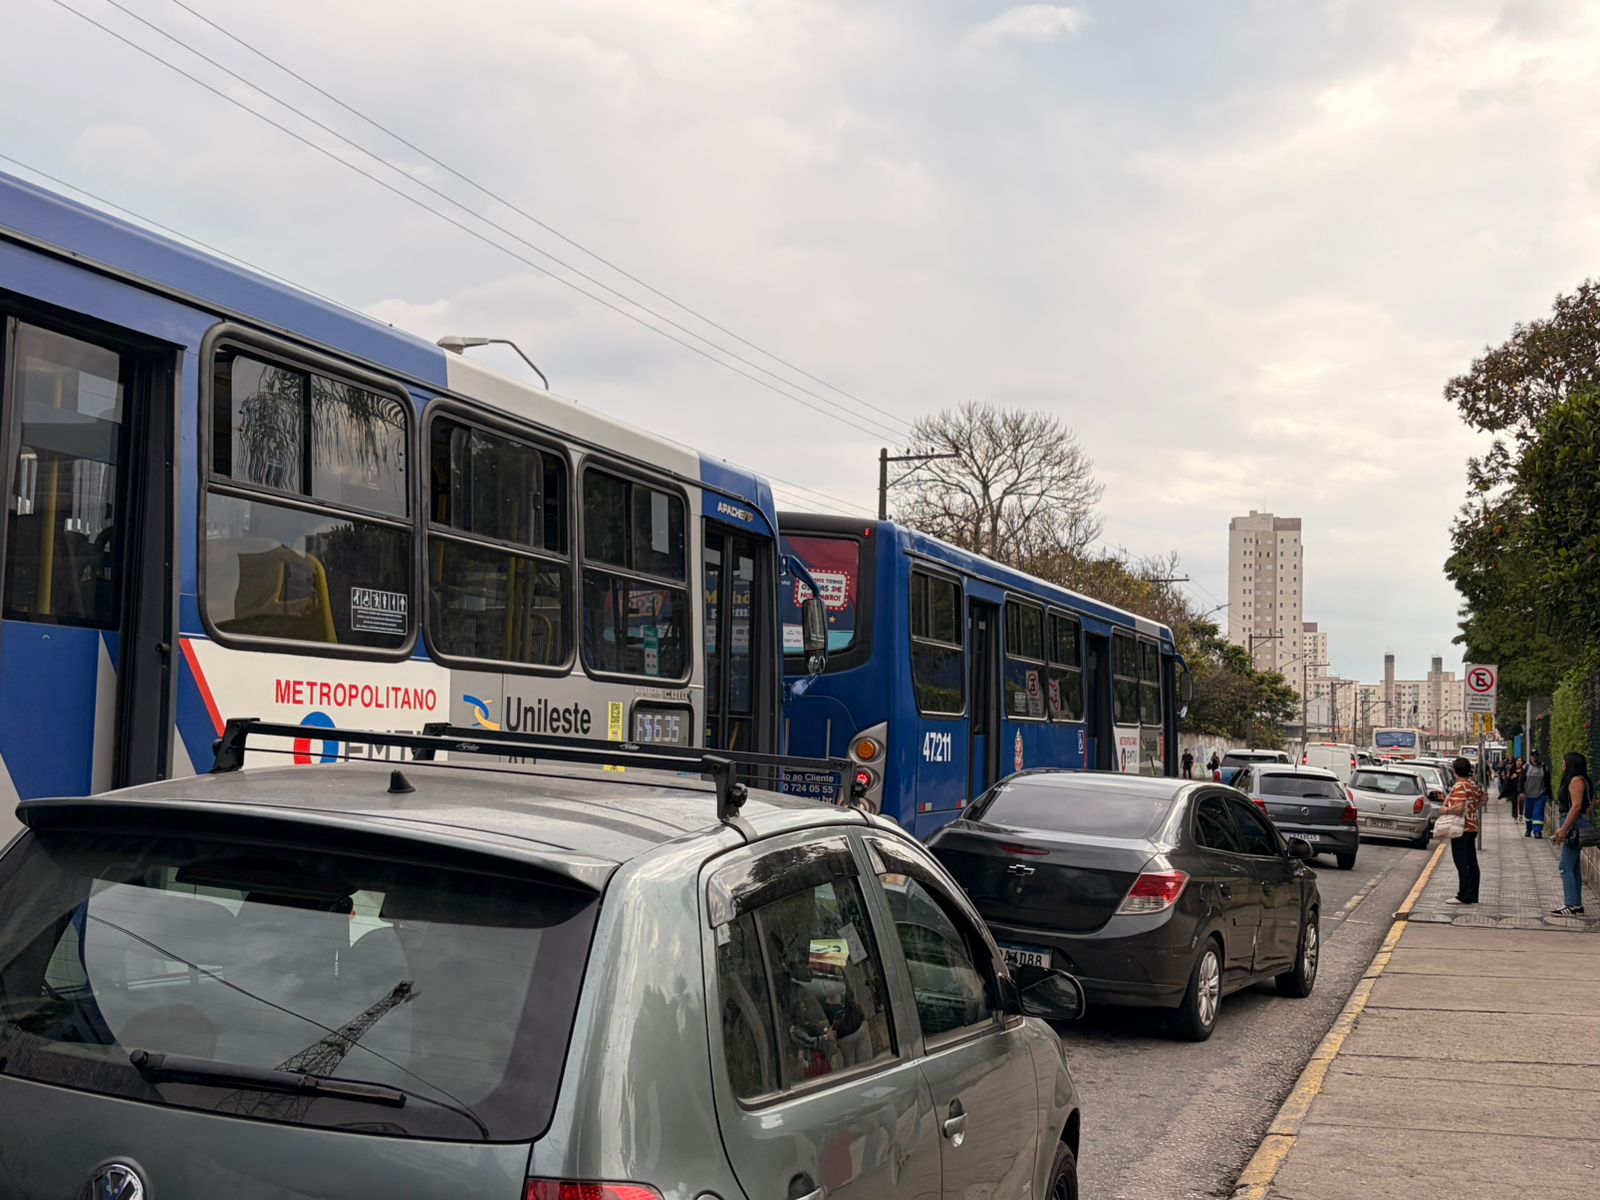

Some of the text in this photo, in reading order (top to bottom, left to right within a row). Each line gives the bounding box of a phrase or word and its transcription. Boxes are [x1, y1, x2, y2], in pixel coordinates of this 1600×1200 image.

[275, 679, 437, 711] METROPOLITANO
[506, 697, 592, 735] Unileste
[805, 773, 834, 783] Cliente
[809, 785, 820, 793] 05
[823, 786, 834, 794] 55
